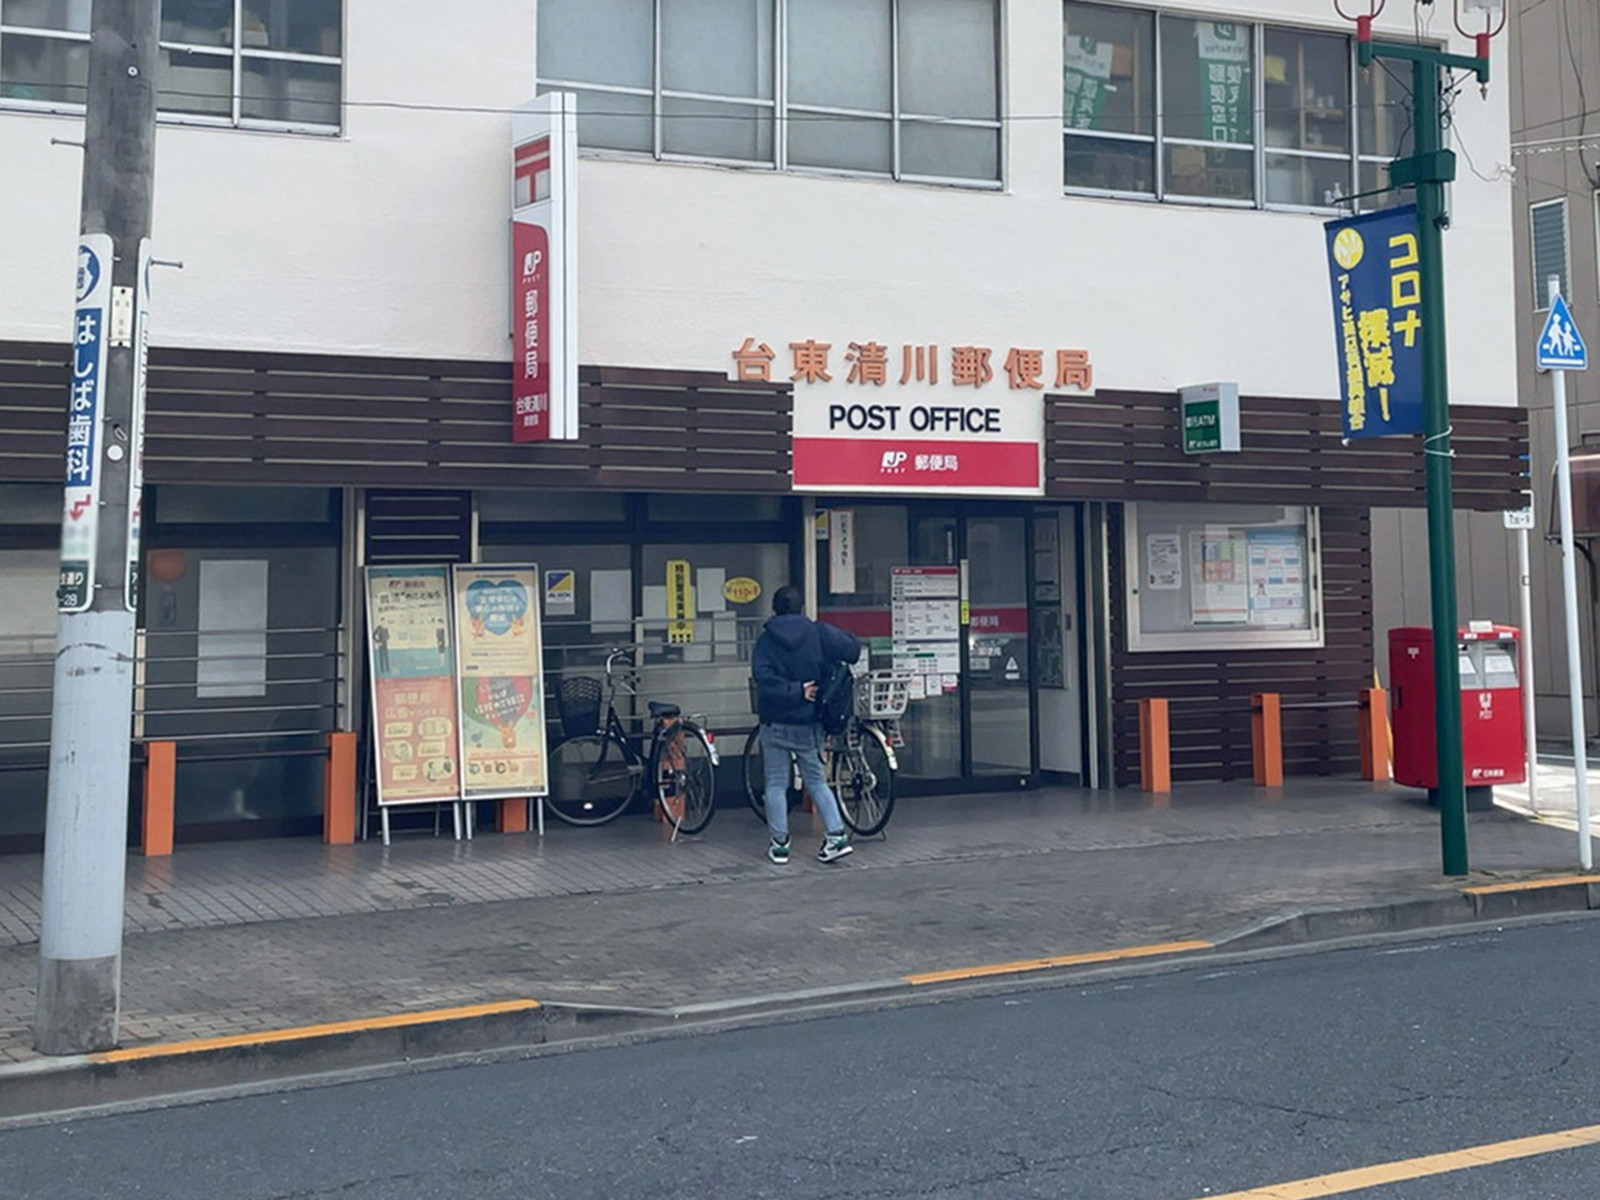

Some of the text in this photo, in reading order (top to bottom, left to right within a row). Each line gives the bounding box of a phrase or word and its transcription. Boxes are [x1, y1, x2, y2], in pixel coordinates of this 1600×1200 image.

[1388, 232, 1422, 348] コロナ
[524, 289, 539, 379] 郵便局
[731, 337, 1094, 391] 台東清川郵便局
[828, 403, 1001, 433] POST OFFICE
[914, 454, 958, 472] 郵便局
